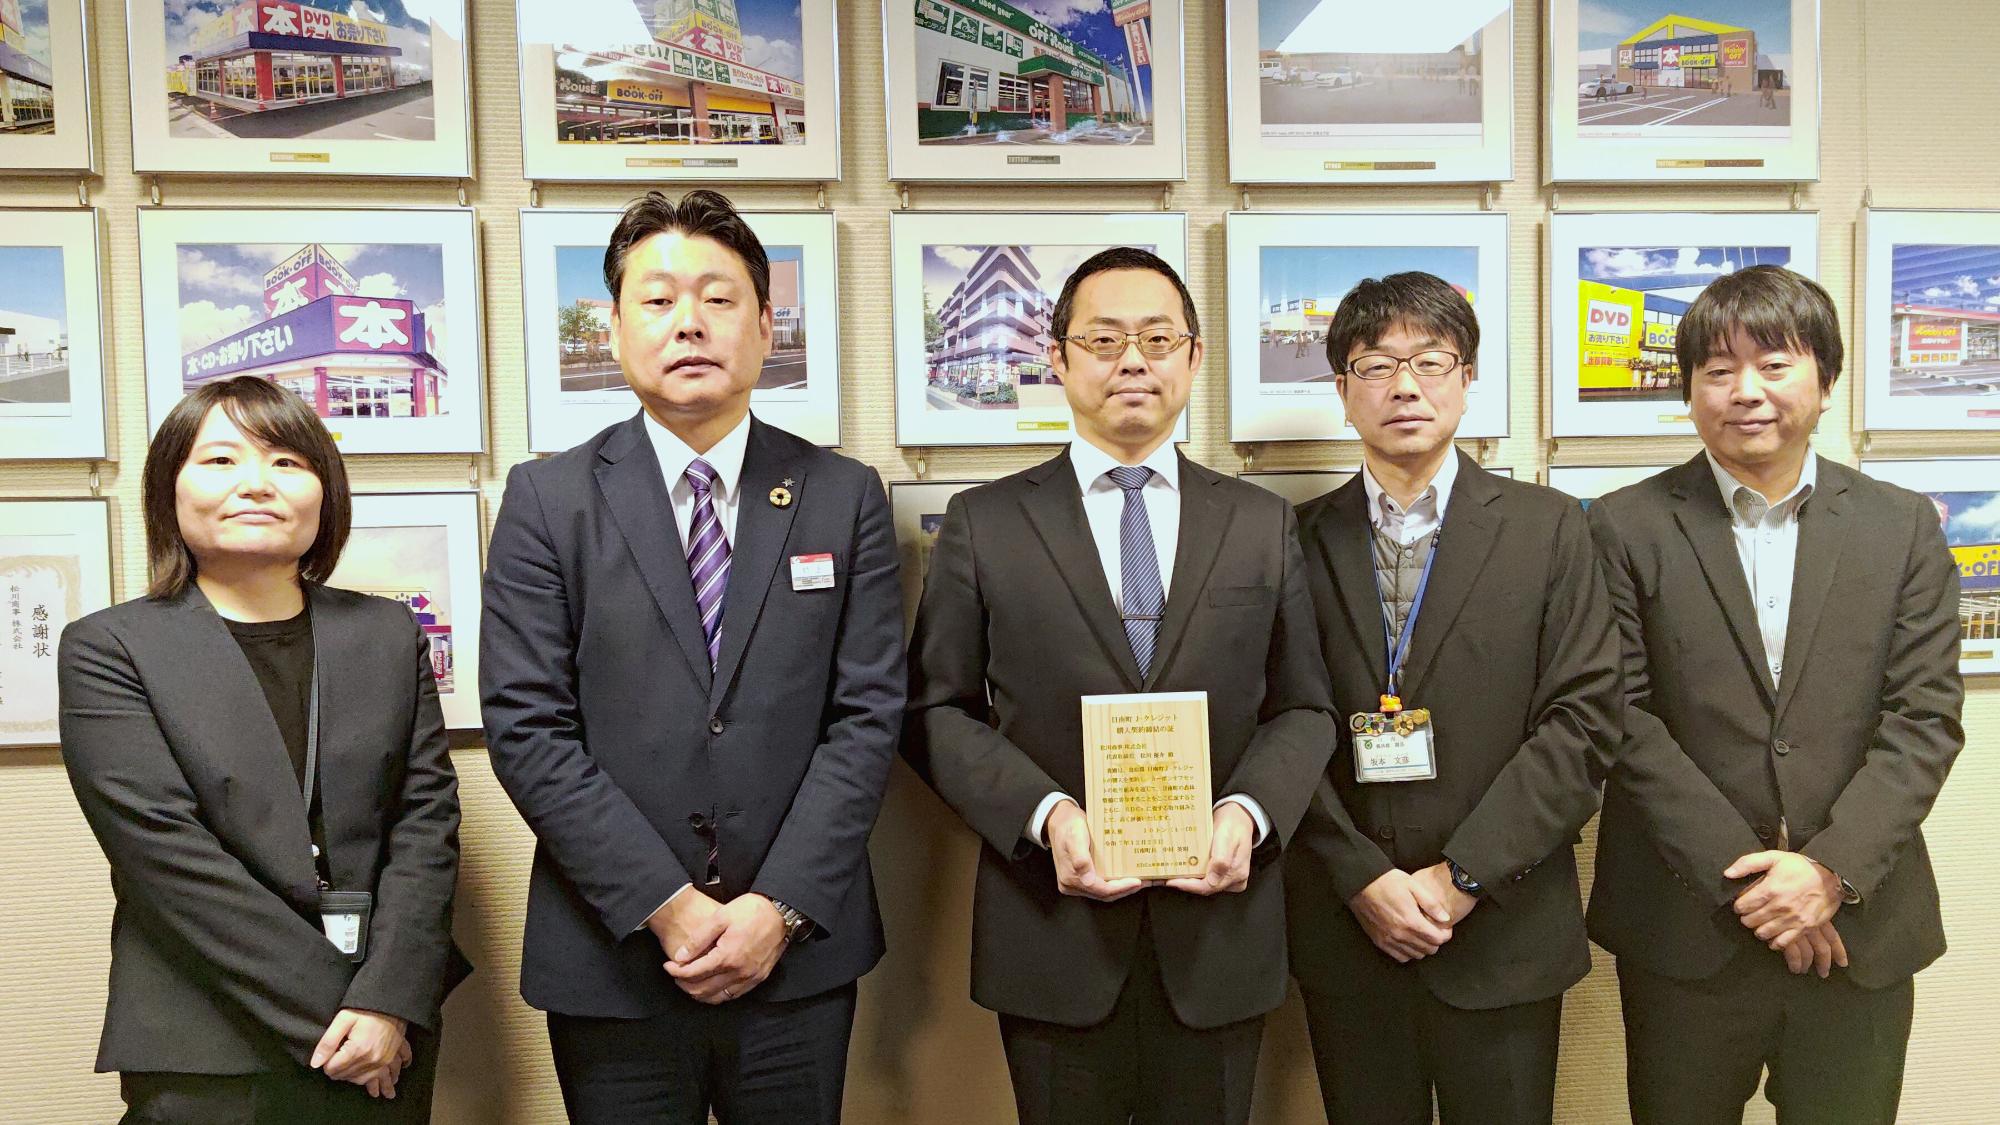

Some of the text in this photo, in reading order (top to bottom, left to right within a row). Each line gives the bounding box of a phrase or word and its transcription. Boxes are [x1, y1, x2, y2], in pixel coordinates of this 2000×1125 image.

[263, 5, 299, 35] 本
[303, 9, 331, 27] DVD
[1662, 47, 1679, 65] 本
[271, 277, 309, 318] 本
[339, 301, 409, 349] 本
[1590, 308, 1630, 327] DVD
[32, 604, 51, 659] 感謝状
